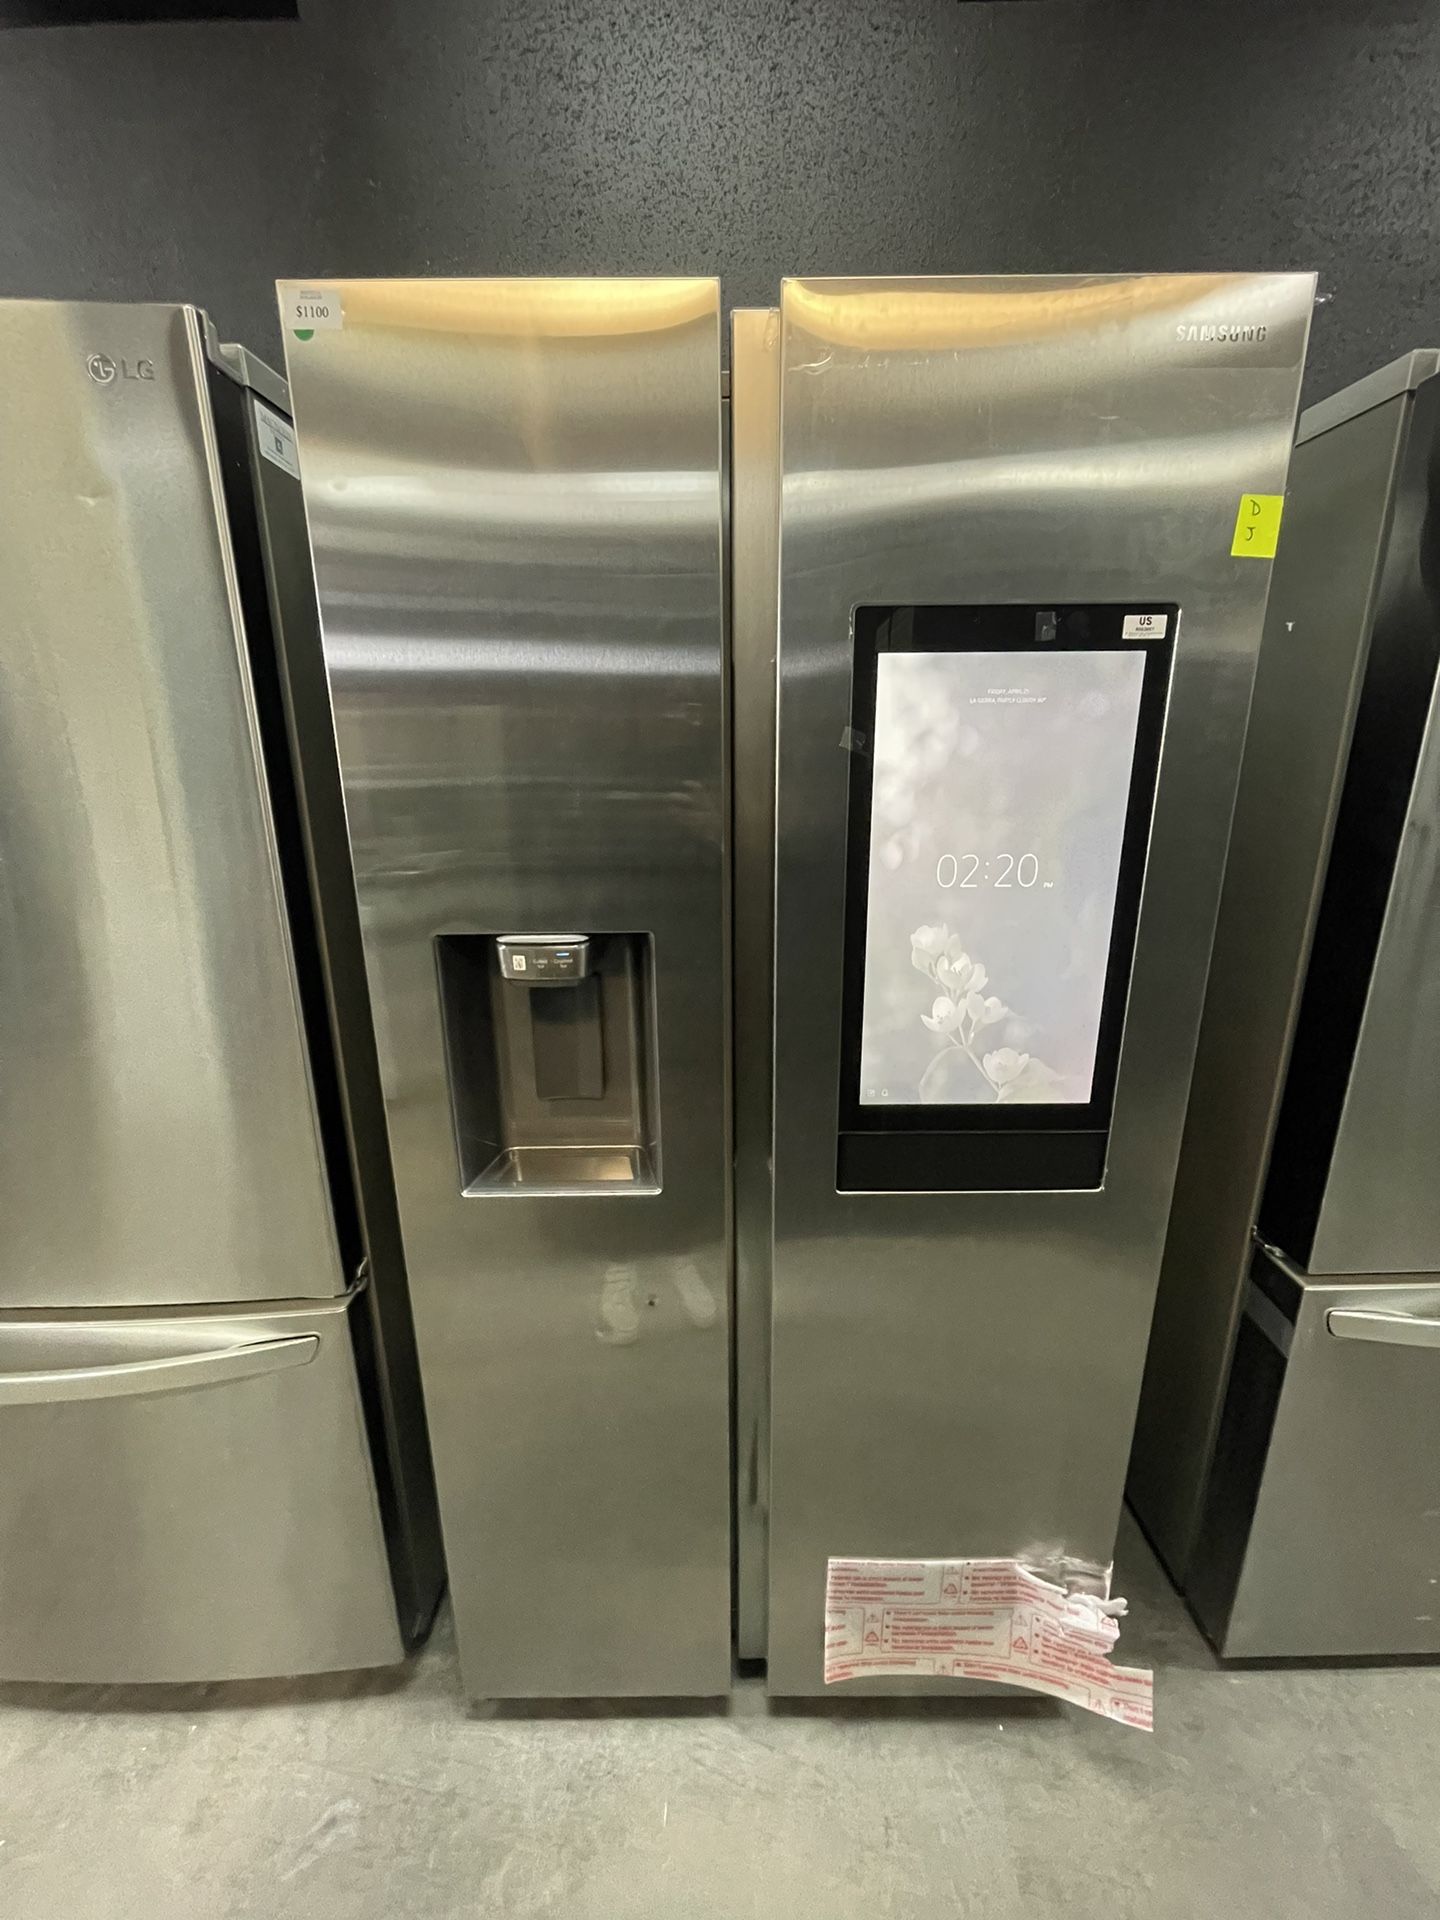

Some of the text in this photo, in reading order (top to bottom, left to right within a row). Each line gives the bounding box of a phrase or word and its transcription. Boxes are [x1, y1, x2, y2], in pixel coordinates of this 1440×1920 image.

[296, 304, 329, 319] $1100
[1175, 324, 1267, 343] SAMSUNG
[121, 358, 155, 380] LG
[1250, 499, 1261, 516] D
[1246, 526, 1256, 541] J
[1139, 616, 1153, 626] US
[936, 853, 1039, 888] 02:20
